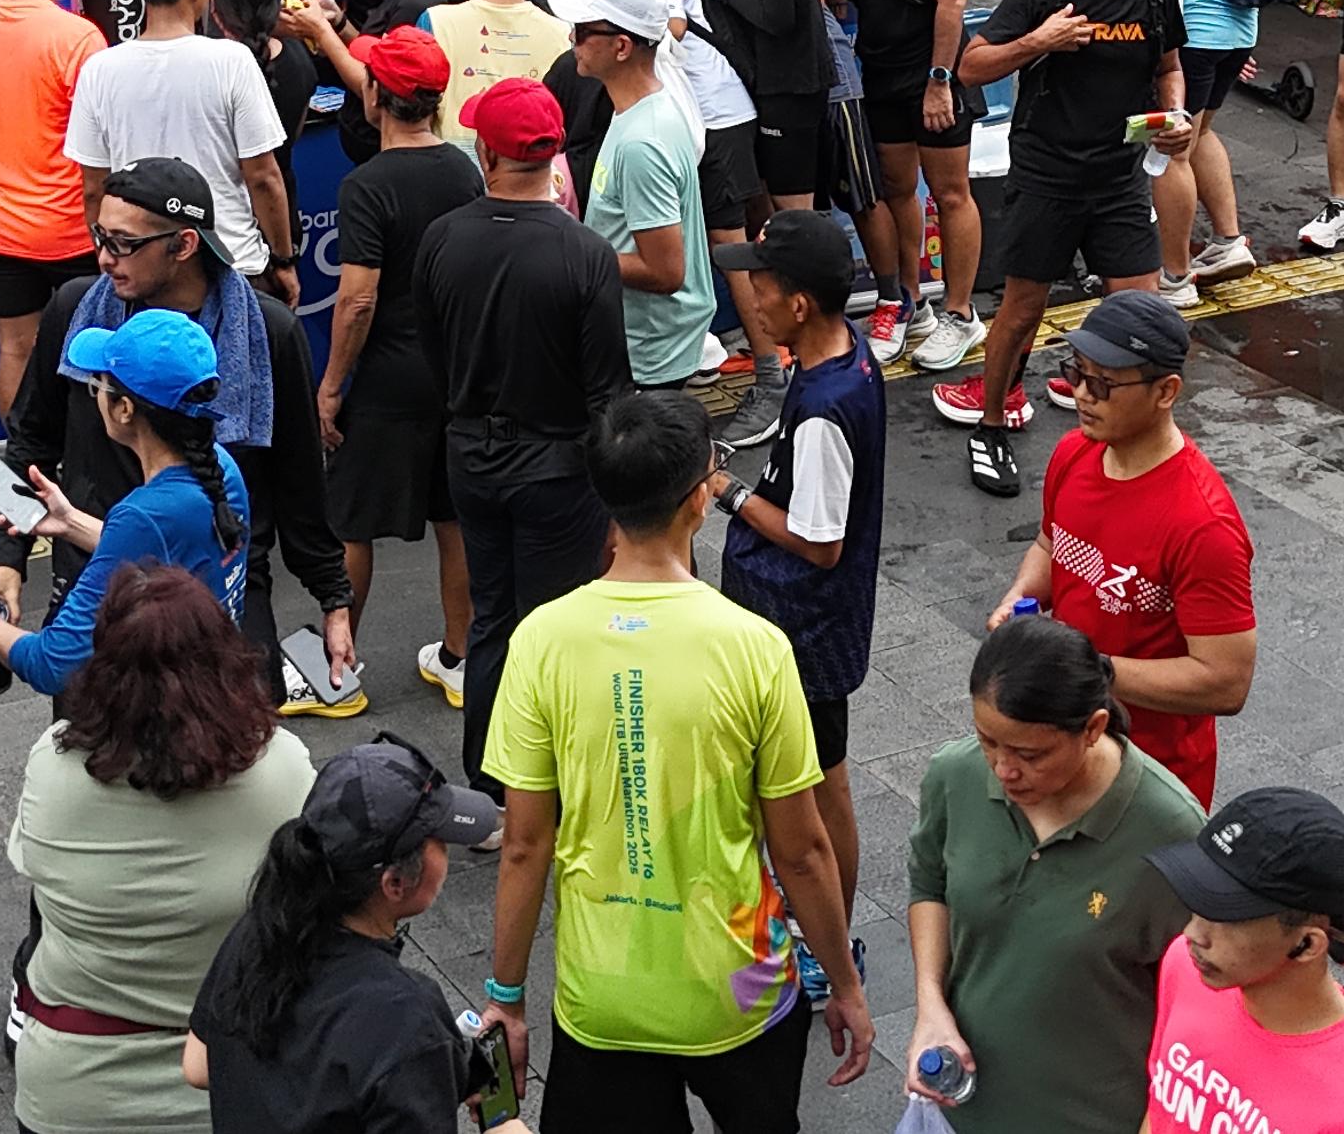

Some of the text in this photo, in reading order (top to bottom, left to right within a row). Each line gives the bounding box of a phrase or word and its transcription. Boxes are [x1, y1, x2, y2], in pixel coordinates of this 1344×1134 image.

[1092, 22, 1146, 41] TRAVA
[611, 673, 639, 876] wondr ITB Ultra Marathon 2025
[628, 668, 655, 880] FINISHER 180K RELAY 16
[603, 892, 684, 913] Jakarta Bandung
